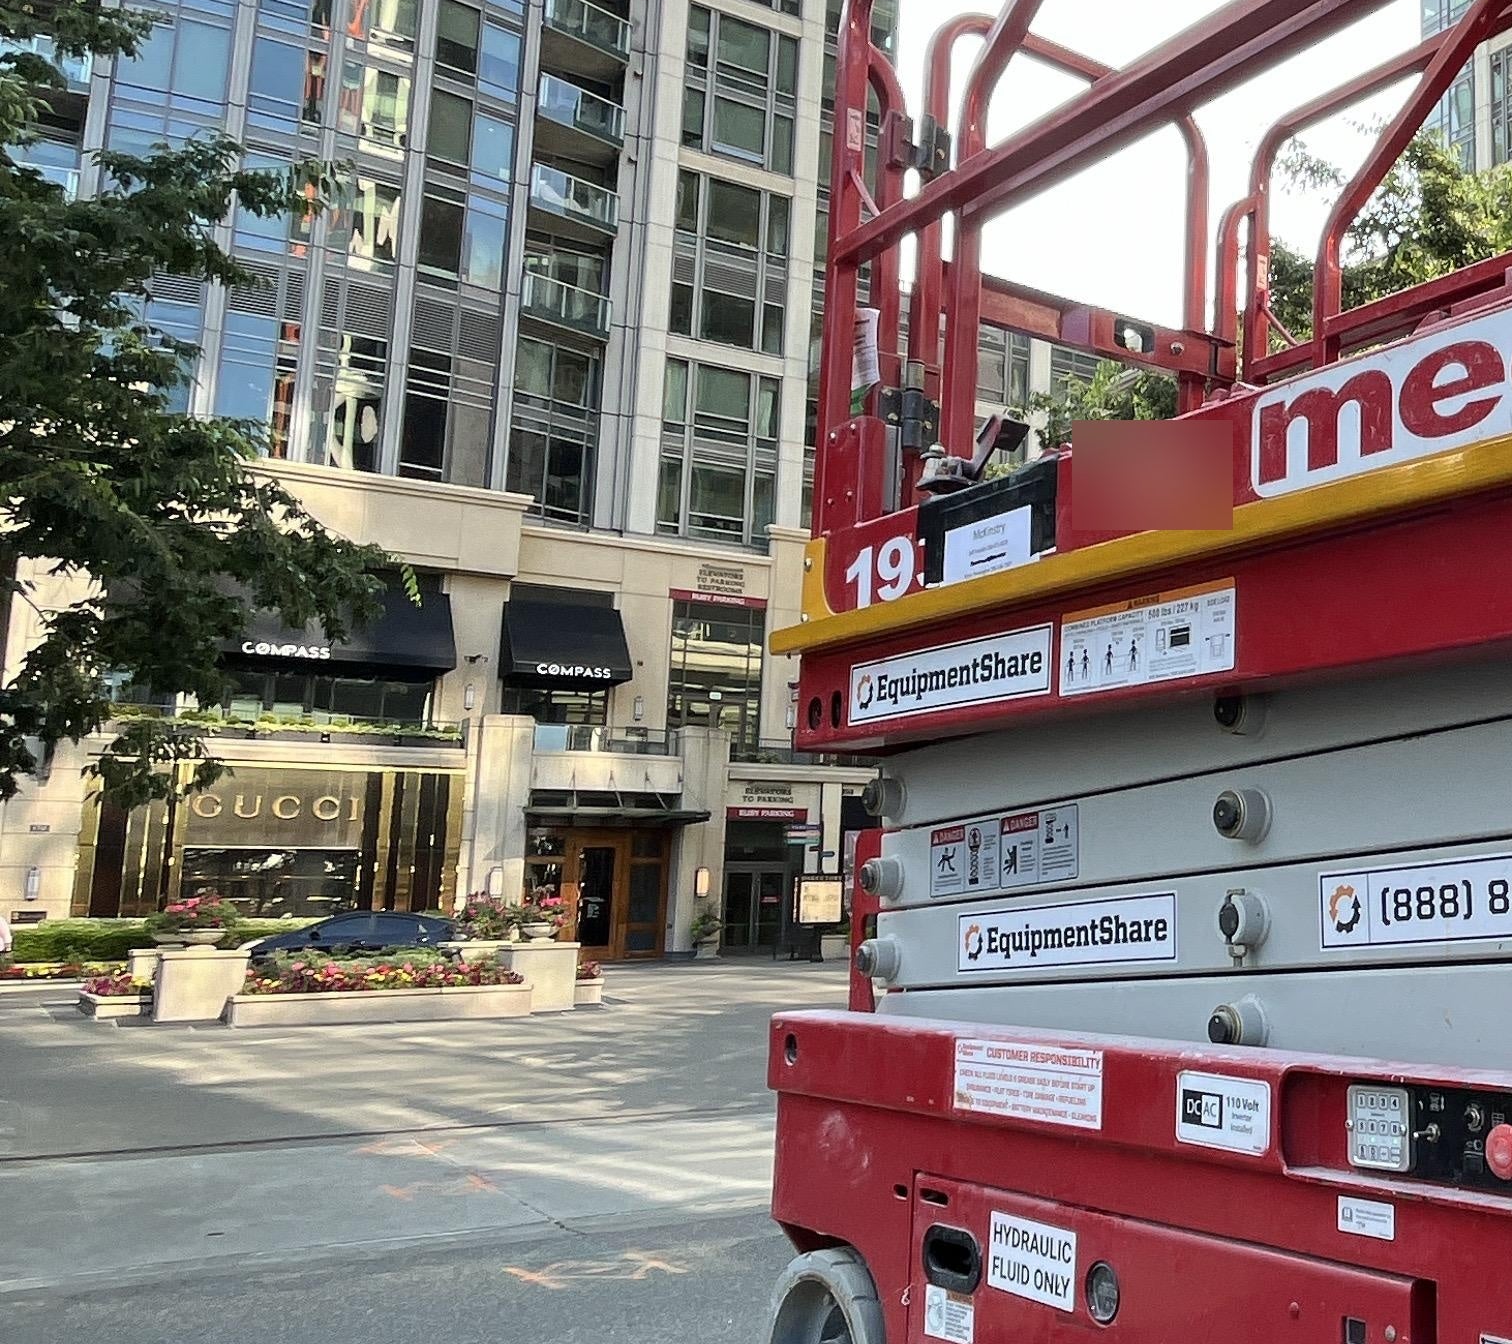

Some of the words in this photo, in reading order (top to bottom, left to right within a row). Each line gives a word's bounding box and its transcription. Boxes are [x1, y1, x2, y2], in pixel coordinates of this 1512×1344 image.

[241, 641, 331, 660] COMPASS
[536, 663, 612, 680] COMPASS
[876, 651, 1042, 704] EquipmentShare
[191, 792, 359, 822] GUCCI
[757, 796, 794, 804] PARKING
[761, 810, 795, 818] PARKING
[1010, 815, 1037, 831] DANGER
[1380, 879, 1473, 926] (888)
[986, 914, 1168, 959] EquipmentShare
[987, 1047, 1029, 1062] CUSTOMER
[1030, 1051, 1101, 1070] RESPONSIBILITY
[1186, 1098, 1202, 1116] DC
[1203, 1102, 1217, 1118] AC
[1226, 1096, 1241, 1109] 110
[1241, 1098, 1260, 1113] Volt
[993, 1222, 1073, 1264] HYDRAULIC
[992, 1256, 1031, 1286] FLUID
[1034, 1268, 1071, 1299] ONLY
